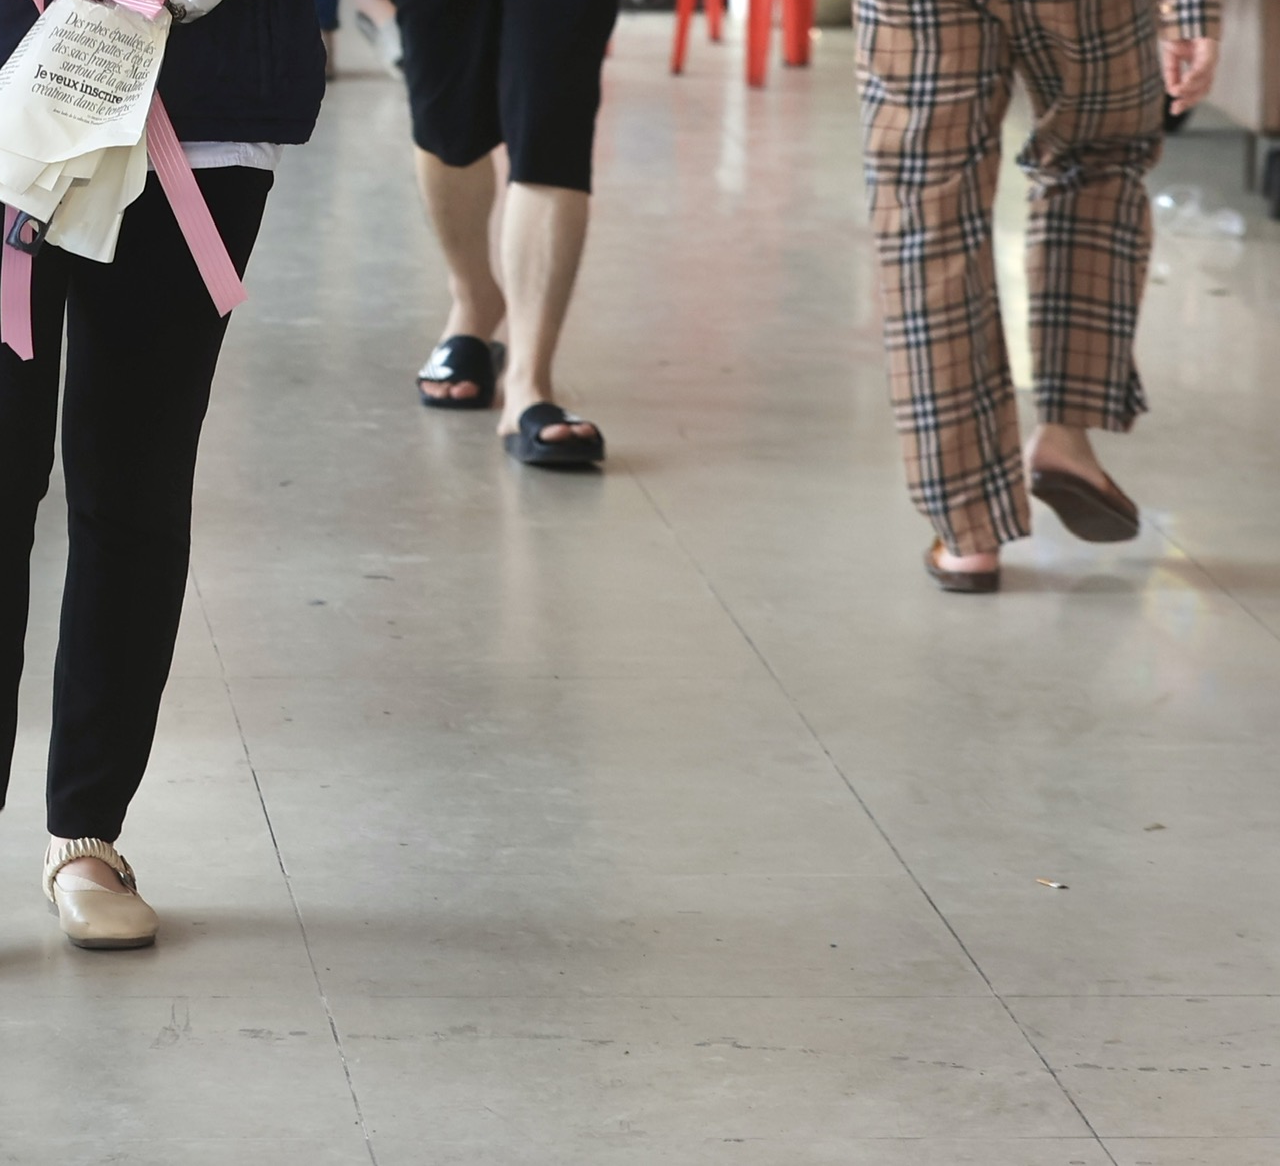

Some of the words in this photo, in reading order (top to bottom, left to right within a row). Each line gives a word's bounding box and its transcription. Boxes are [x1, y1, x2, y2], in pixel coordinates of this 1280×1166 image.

[48, 26, 97, 48] pantalons
[65, 12, 84, 30] Des
[85, 20, 108, 37] robes
[52, 39, 67, 55] des
[68, 48, 86, 62] sacs
[34, 64, 48, 79] Je
[49, 72, 78, 92] veux
[79, 80, 123, 105] inscrire
[60, 60, 94, 79] surtout
[95, 68, 108, 84] de
[107, 71, 117, 87] la
[31, 80, 74, 107] créations
[74, 92, 97, 112] dans
